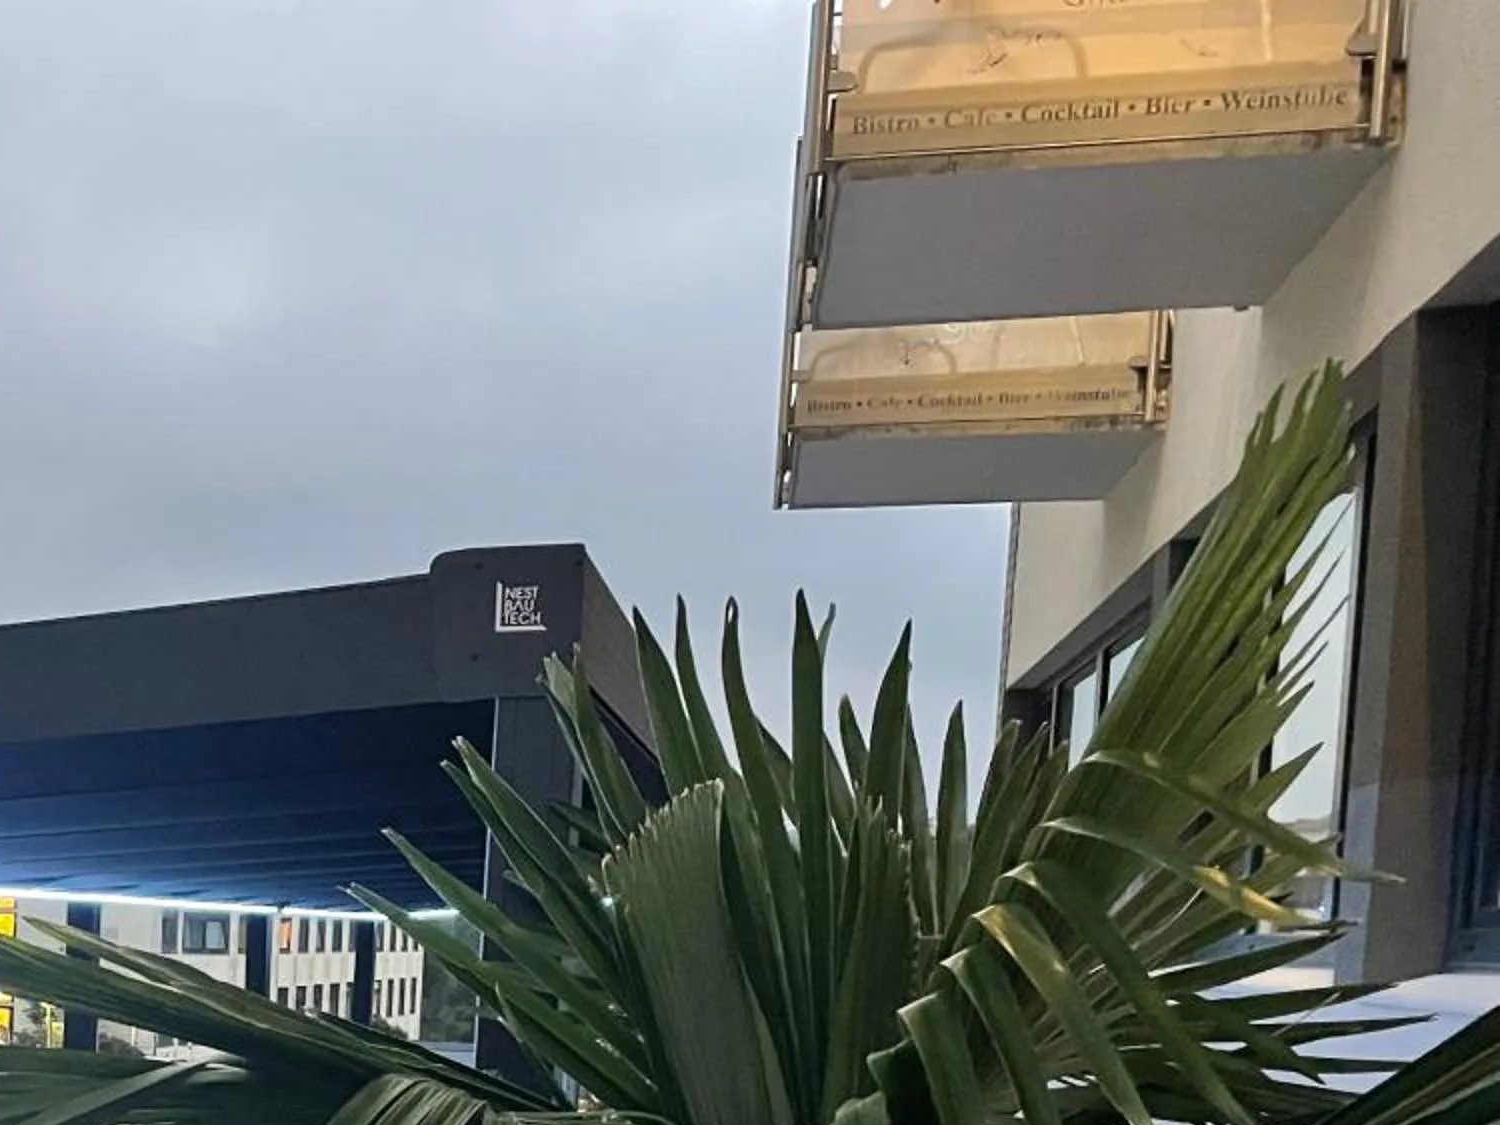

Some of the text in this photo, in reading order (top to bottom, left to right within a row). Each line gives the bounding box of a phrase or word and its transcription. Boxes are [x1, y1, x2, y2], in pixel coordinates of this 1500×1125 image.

[852, 114, 920, 136] Bistro
[1020, 98, 1119, 124] Cocktail
[1145, 96, 1196, 116] Bier
[1219, 86, 1348, 112] Weinstube
[504, 586, 539, 600] NEST
[504, 600, 535, 612] BAU
[504, 611, 541, 625] TECH
